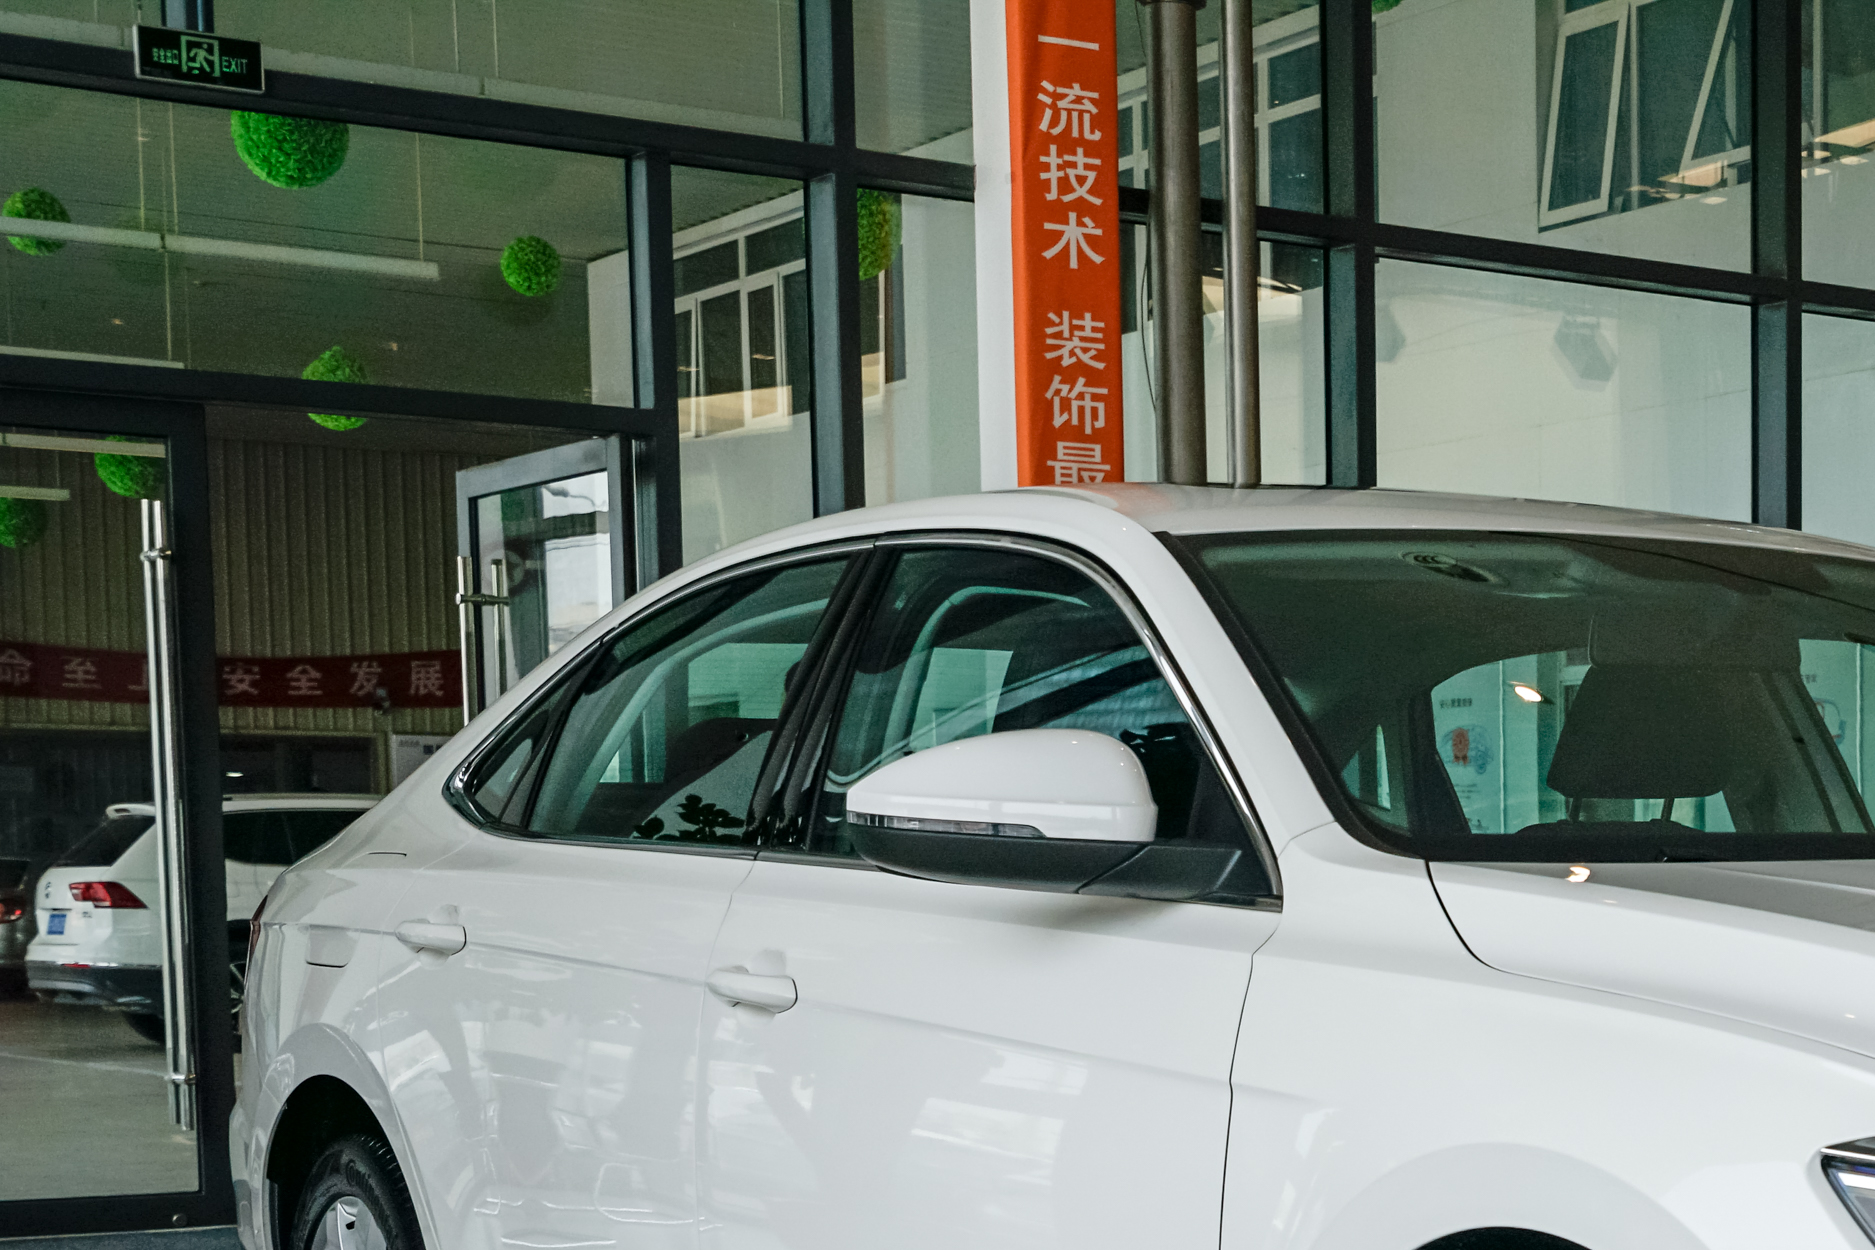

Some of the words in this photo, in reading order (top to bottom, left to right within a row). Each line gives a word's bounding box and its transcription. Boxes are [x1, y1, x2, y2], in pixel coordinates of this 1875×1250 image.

[222, 56, 248, 74] EXIT
[1037, 33, 1105, 269] 一流技术
[222, 660, 444, 698] 安全发展
